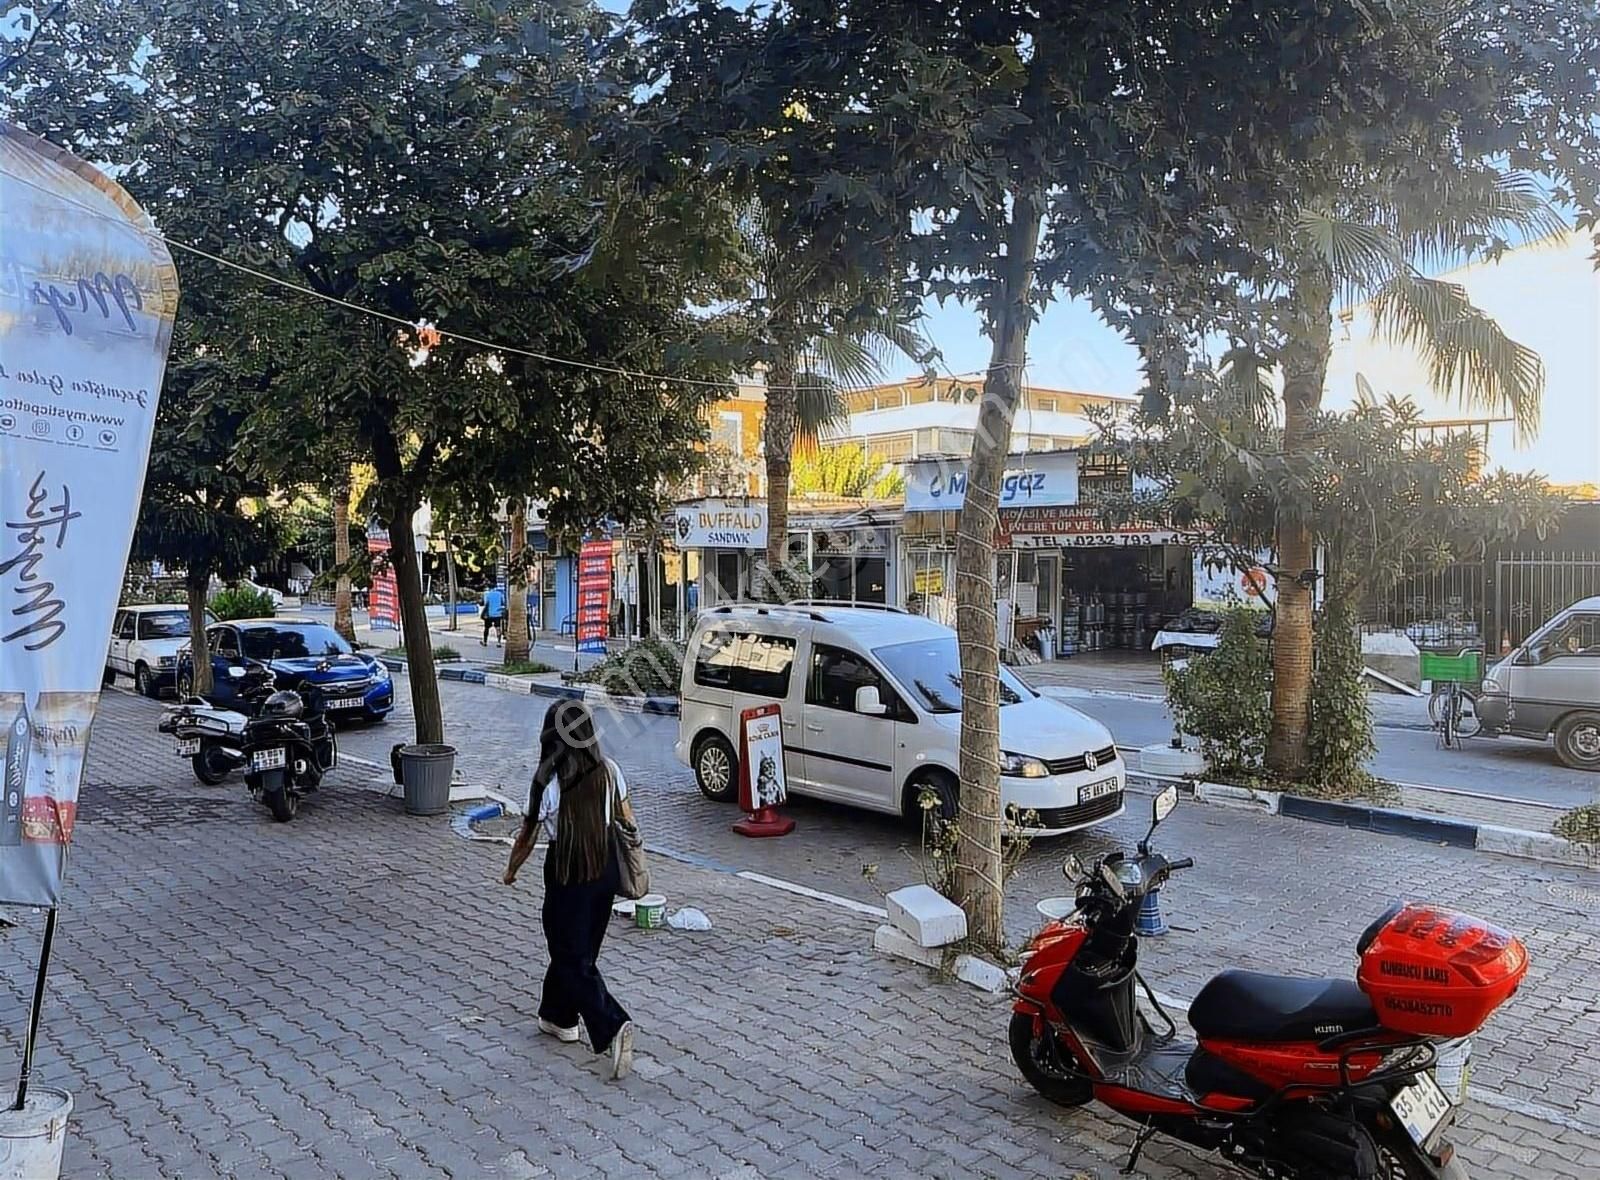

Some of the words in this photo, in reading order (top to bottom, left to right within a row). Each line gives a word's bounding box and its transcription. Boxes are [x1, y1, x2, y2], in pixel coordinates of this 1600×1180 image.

[698, 511, 763, 530] BUFFALO
[1031, 536, 1062, 547] TEL
[1120, 534, 1152, 546] 793
[1395, 1094, 1414, 1120] 35
